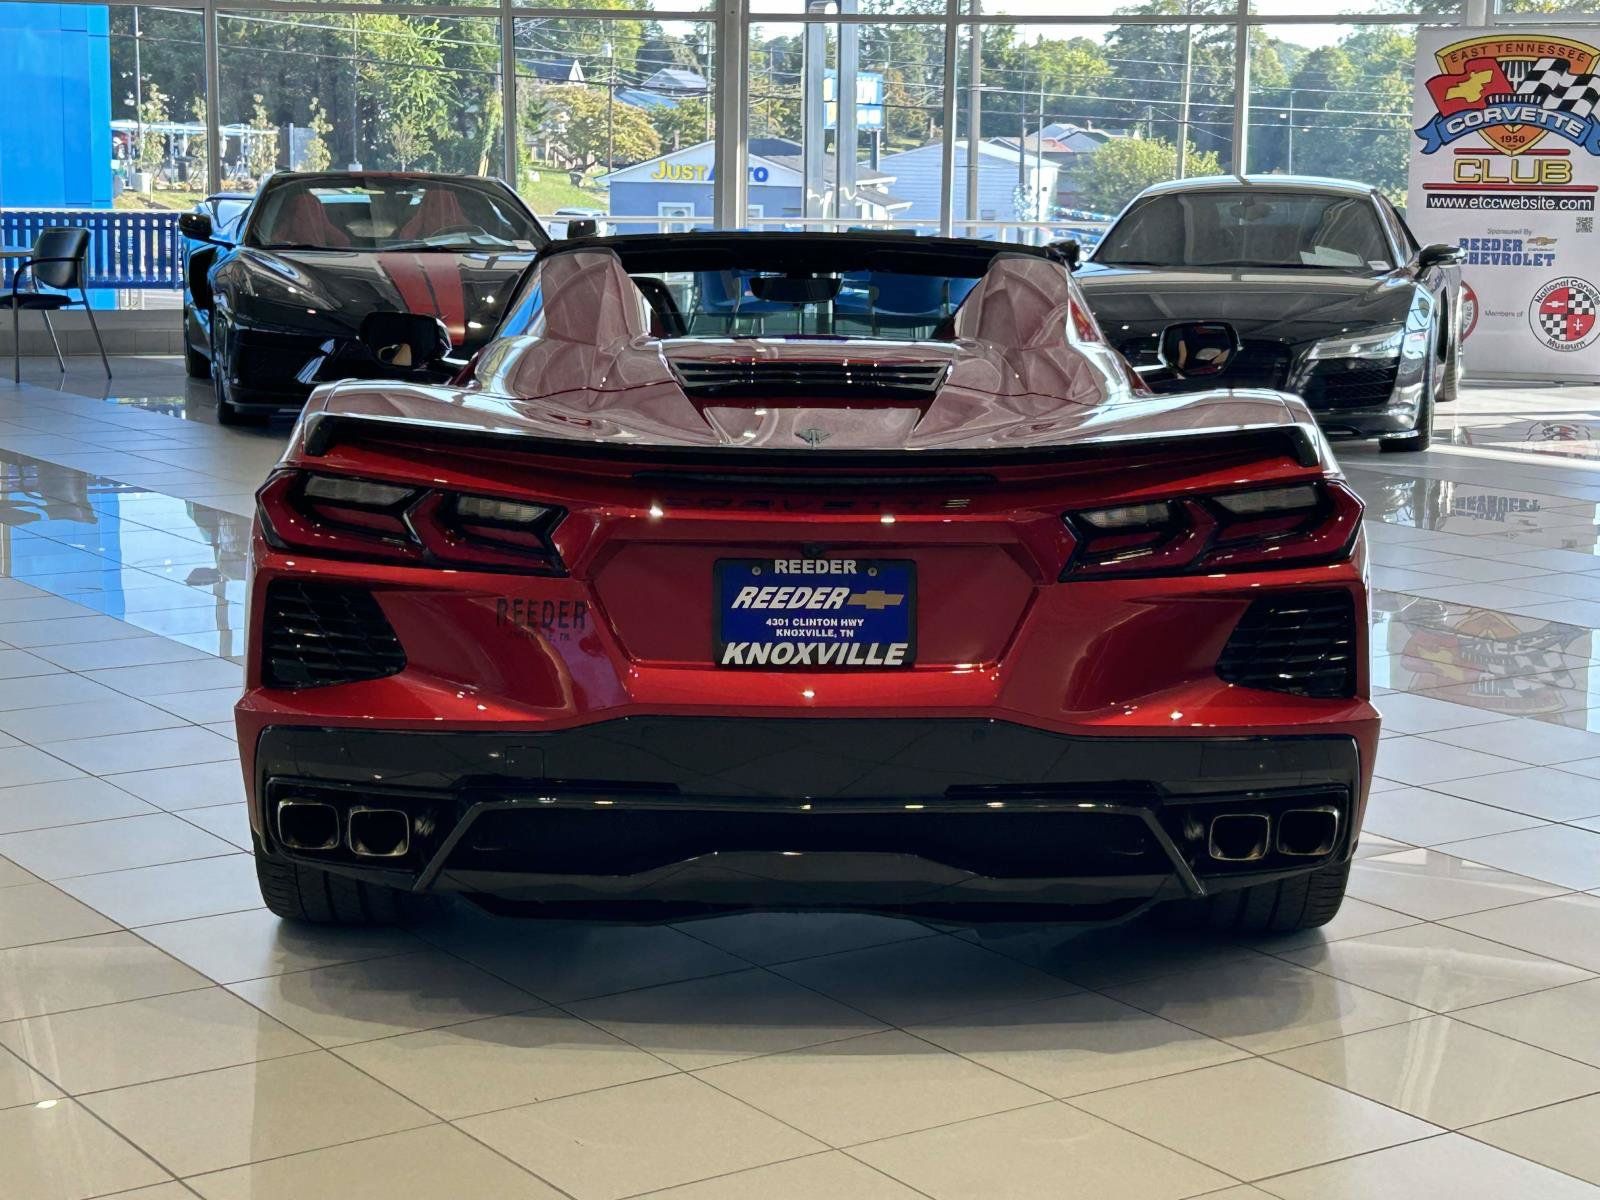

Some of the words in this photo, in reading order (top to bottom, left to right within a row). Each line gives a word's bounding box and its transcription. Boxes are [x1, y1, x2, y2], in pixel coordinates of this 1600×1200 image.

[1450, 46, 1488, 64] EAST
[1496, 42, 1586, 63] TENNESSEE
[1445, 106, 1586, 138] CORVETTE
[1500, 135, 1525, 144] 1950
[651, 160, 708, 180] JUST
[1453, 158, 1573, 185] CLUB
[1429, 195, 1592, 211] www.etccwebsite.com
[1459, 238, 1523, 252] REEDER
[1534, 279, 1569, 304] National
[1546, 339, 1586, 350] Museum
[774, 559, 858, 575] REEDER
[731, 586, 850, 610] REEDER
[495, 598, 588, 630] REEDER
[765, 618, 789, 626] 4301
[792, 618, 838, 627] CLINTON
[840, 618, 864, 627] HWY
[775, 629, 837, 638] KNOXVILLE,
[840, 629, 854, 638] TN
[721, 642, 909, 667] KNOXVILLE
